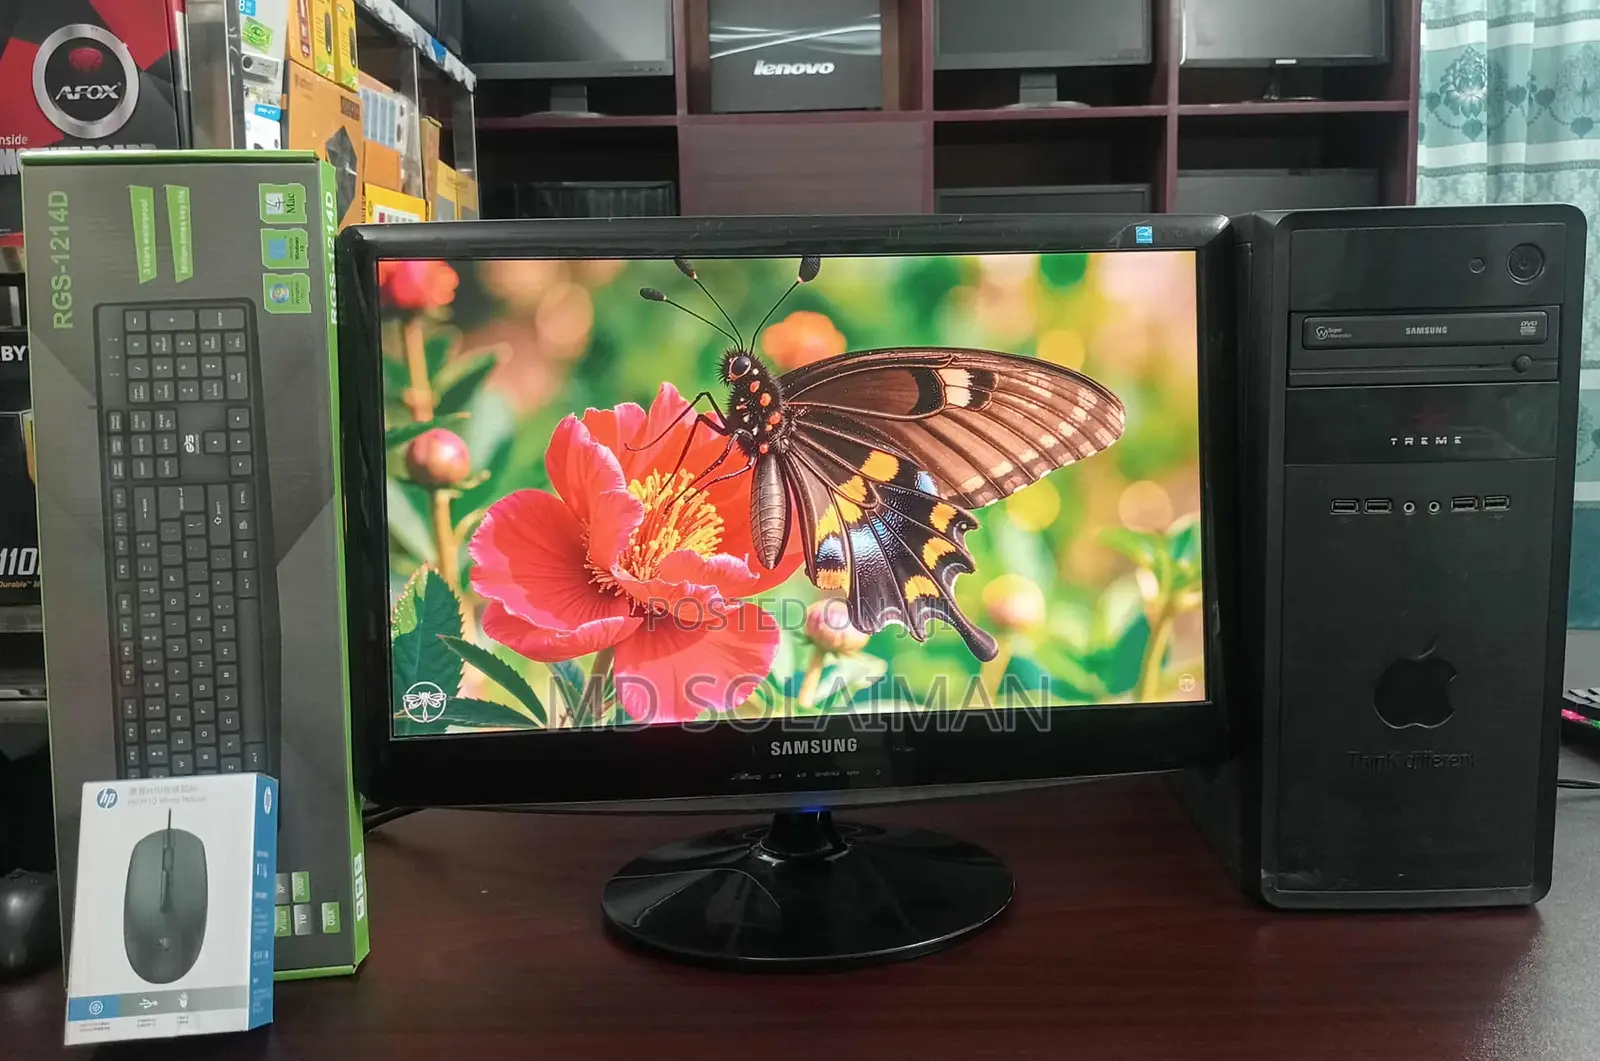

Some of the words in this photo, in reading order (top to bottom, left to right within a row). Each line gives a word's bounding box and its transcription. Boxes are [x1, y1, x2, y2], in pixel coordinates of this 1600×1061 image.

[753, 60, 835, 75] lenovo
[55, 85, 119, 100] AFOX
[286, 192, 296, 214] Mac
[48, 190, 73, 329] RGS-1214D
[1405, 326, 1447, 335] SAMSUNG
[1, 345, 26, 361] BY
[1390, 436, 1462, 446] TREME
[0, 547, 40, 576] 110
[770, 738, 858, 756] SAMSUNG
[98, 789, 117, 808] hp
